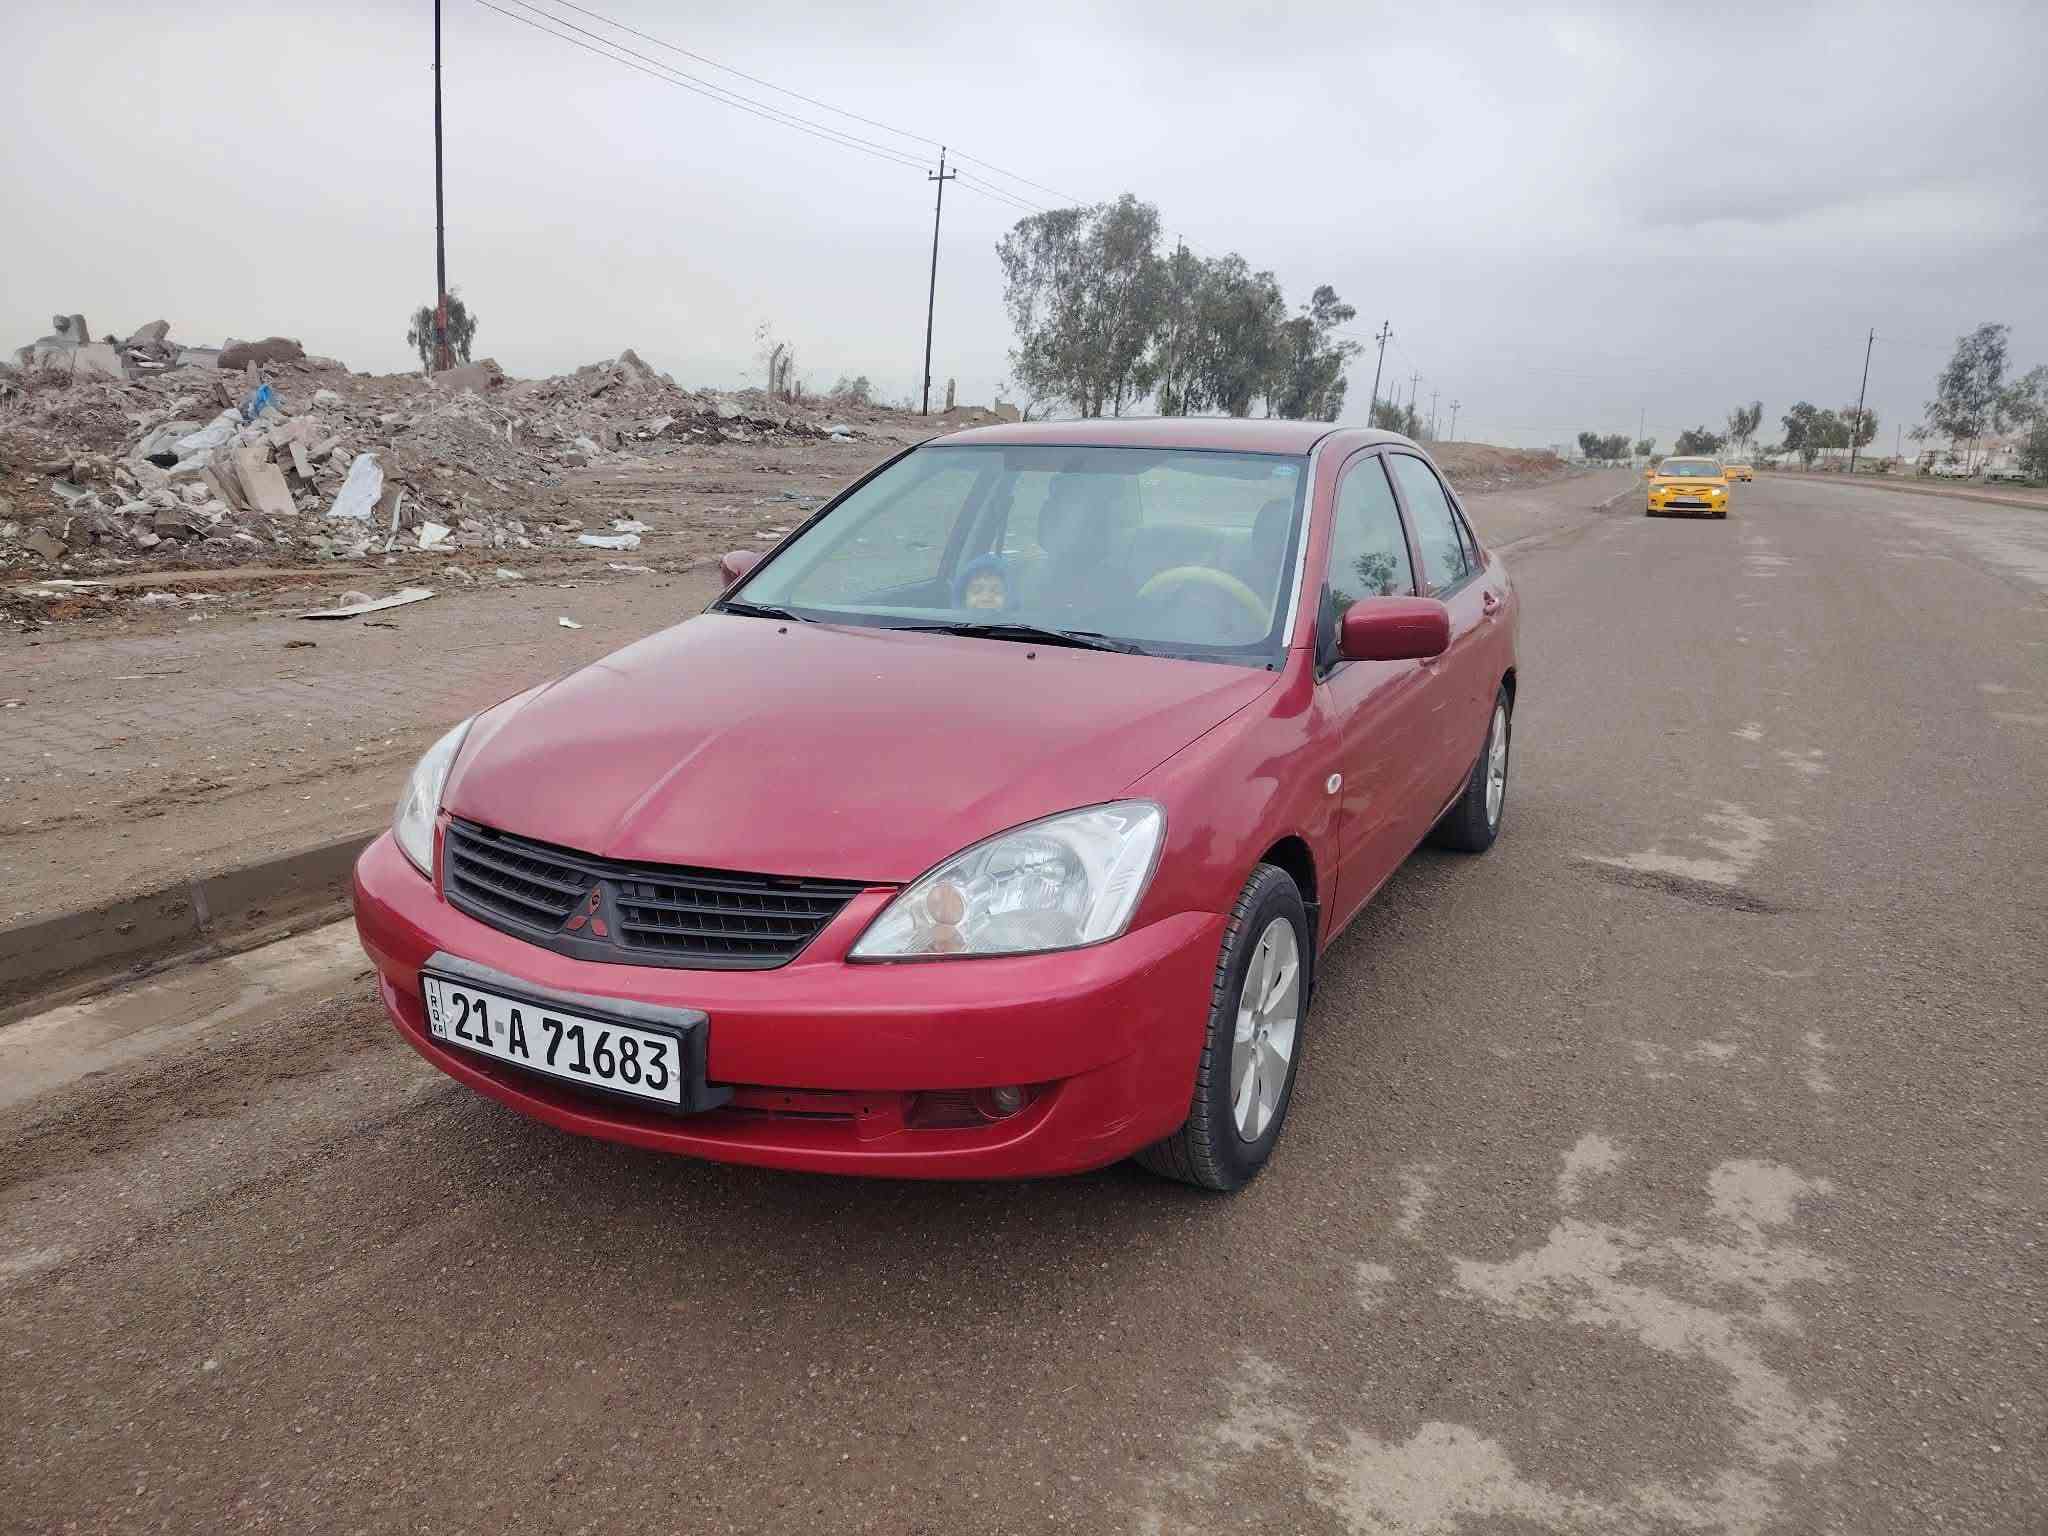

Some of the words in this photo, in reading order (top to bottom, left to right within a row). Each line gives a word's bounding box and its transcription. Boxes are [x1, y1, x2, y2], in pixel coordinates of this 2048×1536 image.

[452, 992, 493, 1047] 21
[508, 1008, 530, 1059] A
[542, 1017, 669, 1091] 71683
